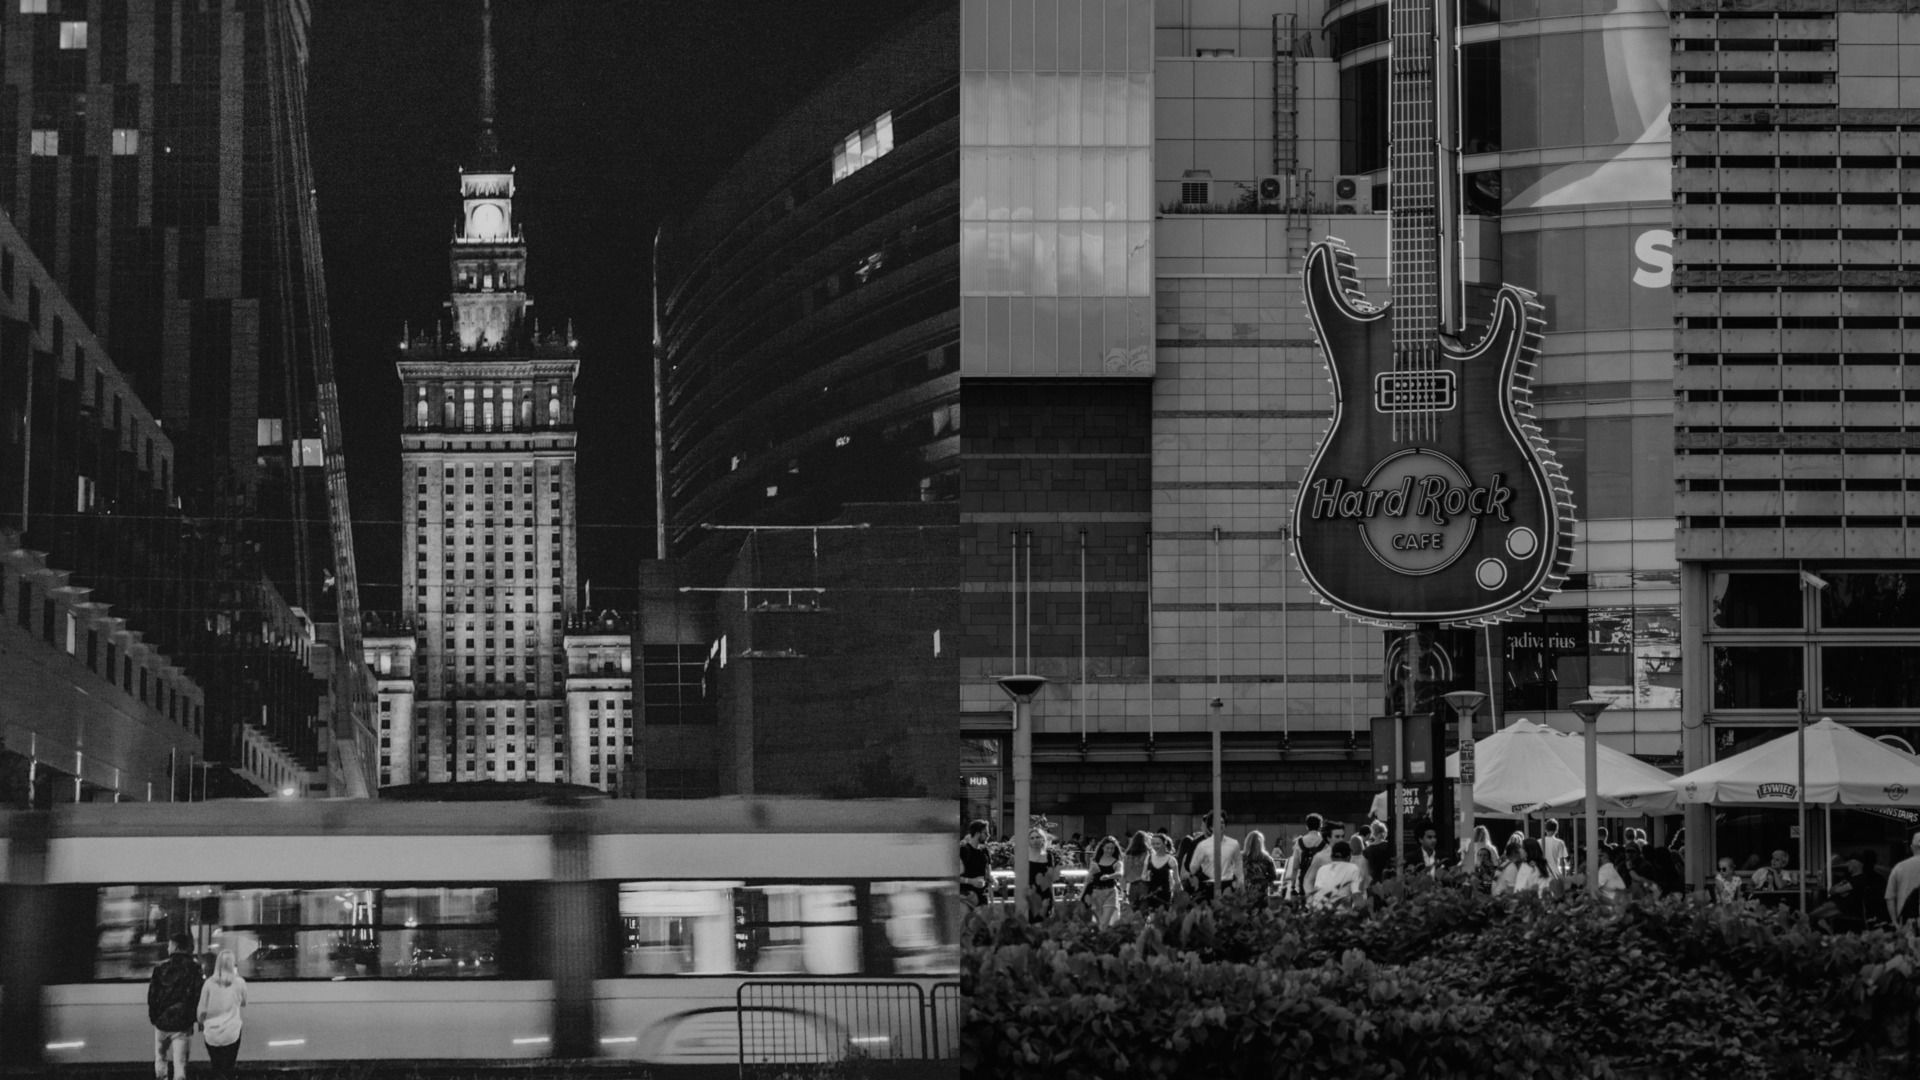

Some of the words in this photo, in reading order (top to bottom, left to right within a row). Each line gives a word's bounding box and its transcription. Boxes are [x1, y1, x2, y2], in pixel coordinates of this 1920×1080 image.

[1312, 476, 1412, 519] Hard
[1417, 474, 1511, 525] Rock
[1392, 533, 1441, 550] CAFE
[969, 777, 988, 785] HUB
